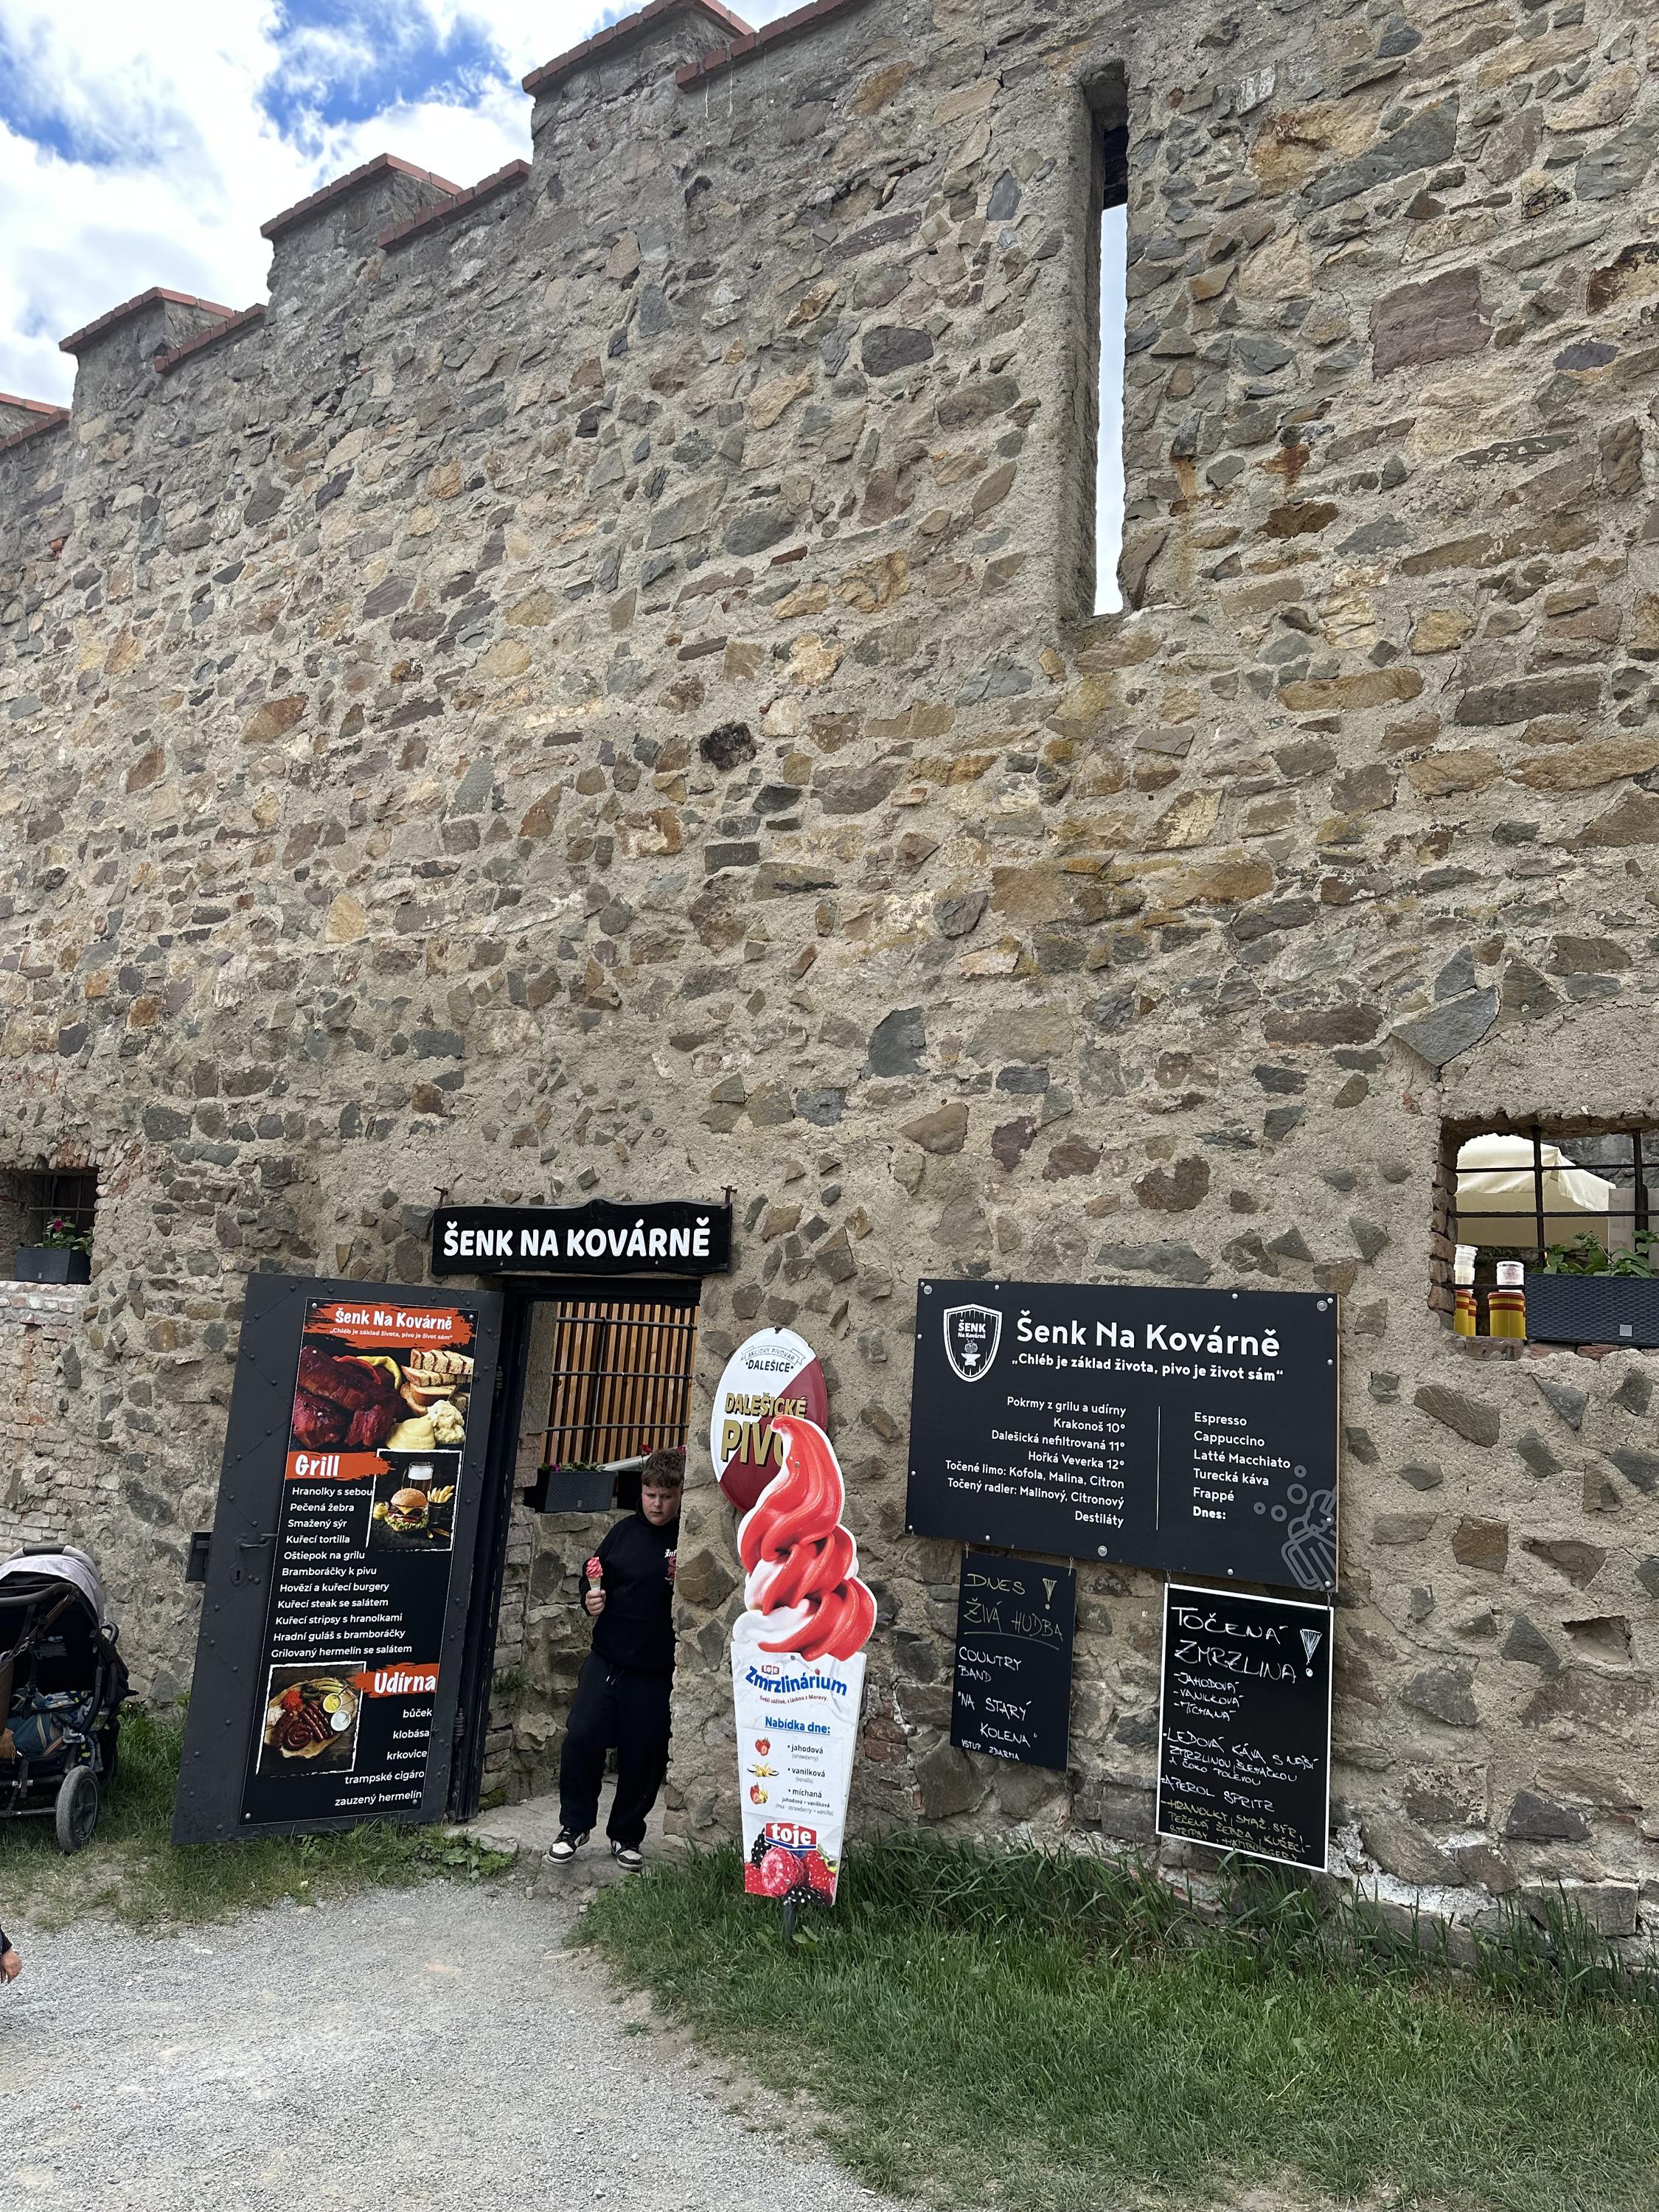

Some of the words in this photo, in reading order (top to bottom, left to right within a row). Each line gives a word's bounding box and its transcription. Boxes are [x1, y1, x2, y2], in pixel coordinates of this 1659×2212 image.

[443, 1220, 513, 1257] ŠENK
[520, 1228, 559, 1257] NA
[566, 1216, 711, 1257] KOVÁRNĚ
[335, 1307, 369, 1325] Šenk
[373, 1310, 393, 1326] Na
[396, 1312, 452, 1330] Kovárně
[958, 1319, 987, 1333] ŠENK
[1017, 1310, 1087, 1346] Šenk
[1096, 1321, 1135, 1349] Na
[1146, 1324, 1280, 1357] Kovárně
[771, 1348, 796, 1361] PIVOVAR
[1012, 1353, 1054, 1366] „Chléb
[1054, 1354, 1068, 1369] je
[1071, 1355, 1111, 1370] základ
[1114, 1358, 1158, 1374] života,
[1162, 1362, 1190, 1377] pivo
[1192, 1364, 1207, 1380] je
[1209, 1364, 1244, 1380] život
[725, 1392, 808, 1419] DALEŠICKÉ
[1007, 1396, 1045, 1411] Pokrmy
[1047, 1402, 1053, 1410] z
[1055, 1401, 1079, 1413] grilu
[1082, 1405, 1088, 1413] a
[1091, 1403, 1127, 1418] udírny
[1054, 1418, 1104, 1432] Krakonoš
[1194, 1411, 1248, 1426] Espresso
[992, 1430, 1040, 1444] Dalešická
[1042, 1436, 1106, 1450] nefiltrovaná
[1194, 1430, 1265, 1447] Cappuccino
[295, 1454, 340, 1477] Grill
[1028, 1451, 1059, 1464] Hořká
[1062, 1453, 1104, 1469] Veverka
[1194, 1449, 1225, 1462] Latté
[1228, 1453, 1291, 1469] Macchiato
[945, 1459, 980, 1472] Točené
[982, 1463, 1006, 1475] limo:
[1009, 1467, 1046, 1481] Kofola,
[1049, 1471, 1087, 1486] Malina,
[1089, 1475, 1124, 1489] Citron
[1193, 1467, 1239, 1483] Turecká
[1242, 1472, 1269, 1486] káva
[292, 1487, 335, 1497] Hranolky
[344, 1488, 372, 1496] sebou
[947, 1478, 982, 1493] Točený
[984, 1483, 1017, 1495] radler:
[1020, 1486, 1068, 1503] Malinový,
[1071, 1492, 1124, 1510] Citronový
[1193, 1486, 1234, 1503] Frappé
[290, 1503, 326, 1512] Pečená
[327, 1503, 354, 1512] žebra
[1193, 1506, 1226, 1520] Dnes:
[288, 1519, 332, 1529] Smažený
[333, 1519, 347, 1529] sýr
[1075, 1510, 1124, 1528] Destiláty
[286, 1535, 318, 1543] Kuřecí
[319, 1535, 350, 1543] tortilla
[284, 1551, 327, 1561] Oštiepok
[344, 1551, 365, 1561] grilu
[282, 1567, 347, 1576] Bramboráčky
[348, 1567, 355, 1575] k
[356, 1566, 377, 1576] pivu
[279, 1583, 313, 1592] Hovězí
[321, 1583, 352, 1592] kuřecí
[352, 1583, 389, 1592] burgery
[964, 1573, 1026, 1595] DNES
[277, 1599, 310, 1609] Kuřecí
[310, 1599, 337, 1608] steak
[352, 1598, 389, 1607] salátem
[275, 1616, 308, 1625] Kuřecí
[308, 1615, 341, 1625] stripsy
[349, 1613, 403, 1622] hranolkami
[963, 1597, 1003, 1634] ŽIVÁ
[1011, 1610, 1063, 1642] HUDBA
[1171, 1606, 1289, 1644] TOČENÁ
[273, 1632, 307, 1641] Hradní
[308, 1631, 335, 1642] guláš
[344, 1630, 406, 1639] bramboráčky
[271, 1648, 317, 1658] Grilovaný
[319, 1646, 361, 1656] hermelín
[375, 1645, 412, 1653] salátem
[959, 1646, 1022, 1672] COUNTRY
[763, 1666, 778, 1674] toje
[1175, 1639, 1297, 1684] ZMRZLINA
[745, 1665, 847, 1696] Zmrzlinárium
[959, 1664, 992, 1683] BAND
[374, 1672, 437, 1694] Udírna
[403, 1708, 433, 1719] bůček
[985, 1697, 1032, 1722] STARÝ
[393, 1729, 430, 1739] klobása
[765, 1716, 805, 1731] Nabídka
[807, 1722, 830, 1734] dne:
[386, 1749, 428, 1761] krkovice
[791, 1745, 824, 1754] jahodová
[961, 1739, 981, 1750] VSTUP
[989, 1746, 1020, 1761] ZDARMA
[1231, 1743, 1267, 1764] KÁVA
[1273, 1754, 1284, 1765] S
[344, 1772, 392, 1784] trampské
[394, 1770, 425, 1781] cigáro
[792, 1767, 825, 1778] vanilková
[1182, 1758, 1208, 1773] ČOKO
[1214, 1767, 1261, 1786] POLEVOU
[335, 1794, 377, 1806] zauzený
[378, 1790, 422, 1802] hermelín
[792, 1789, 822, 1798] míchaná
[1223, 1790, 1275, 1812] SPRITZ
[771, 1823, 812, 1848] toje
